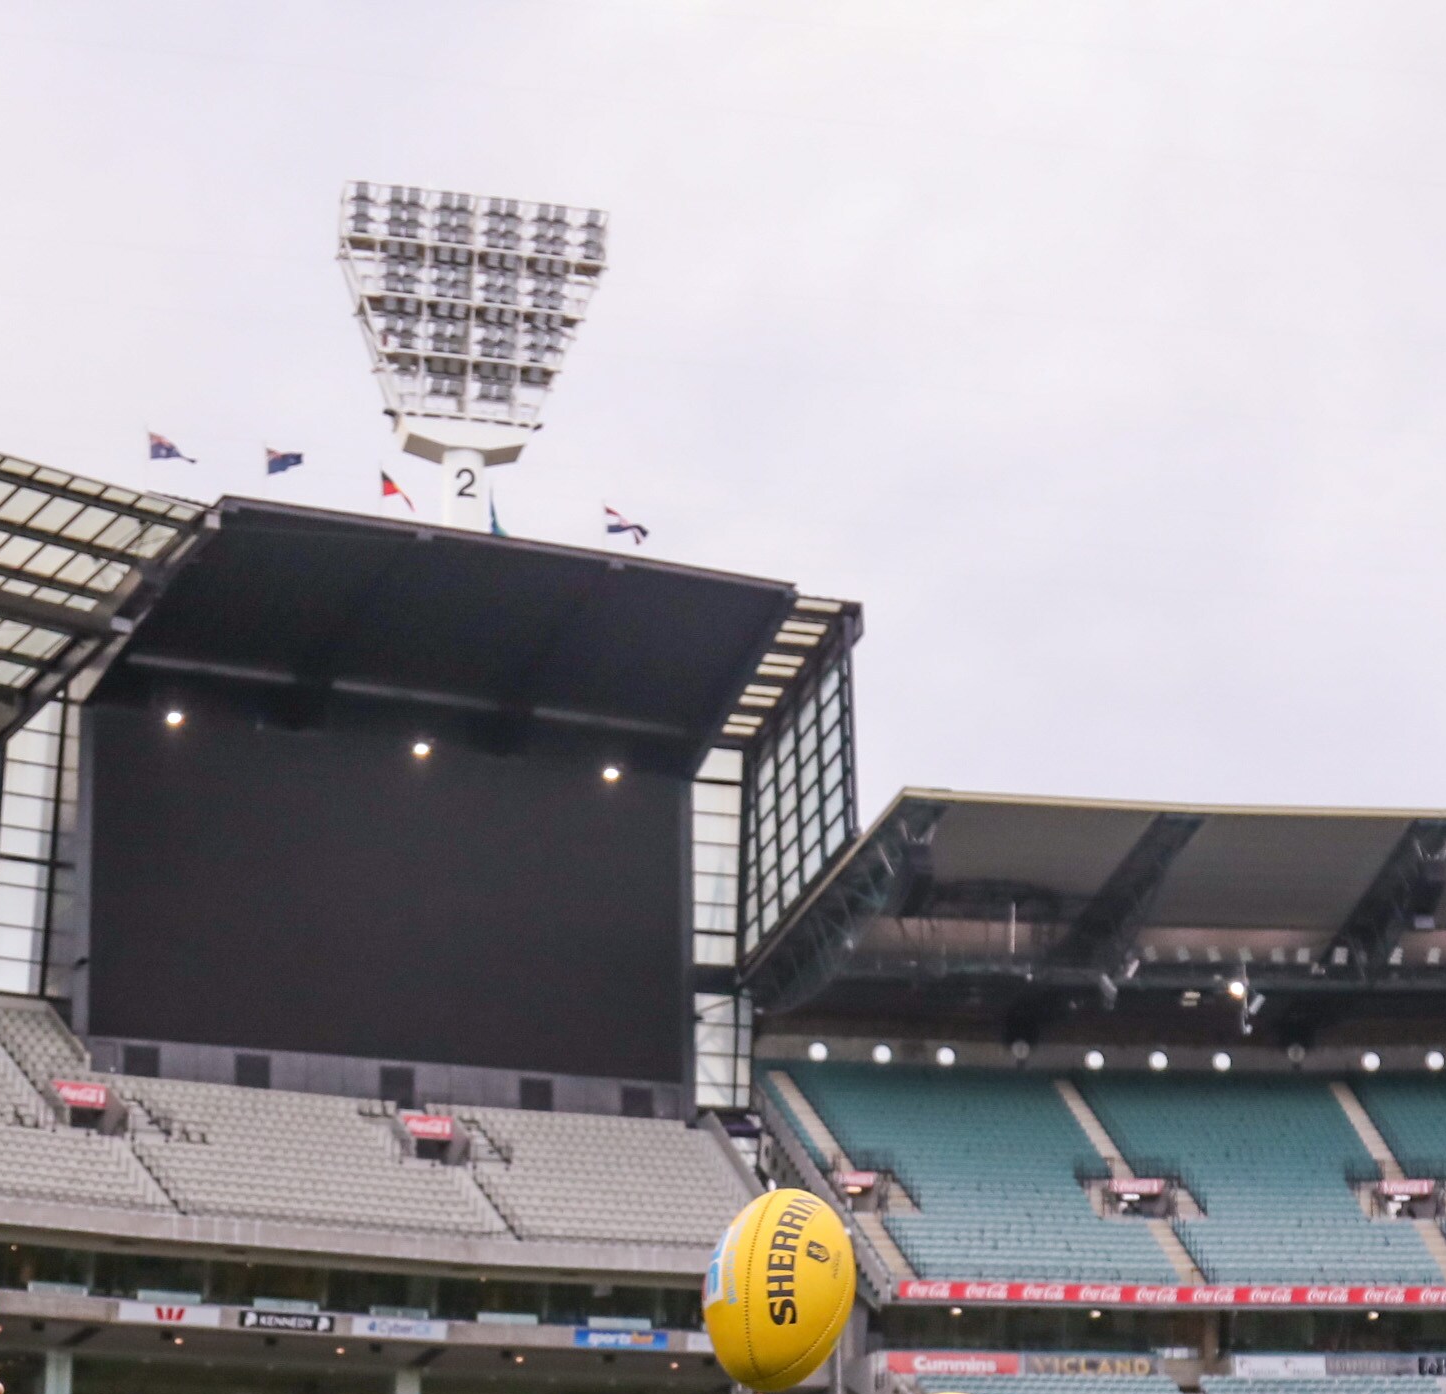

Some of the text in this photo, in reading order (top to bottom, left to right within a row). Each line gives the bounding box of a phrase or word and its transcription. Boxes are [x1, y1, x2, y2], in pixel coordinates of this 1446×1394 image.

[456, 468, 476, 498] 2
[766, 1192, 822, 1326] SHERRIN
[259, 1314, 314, 1330] KENNEDY
[914, 1355, 997, 1373] Cummins
